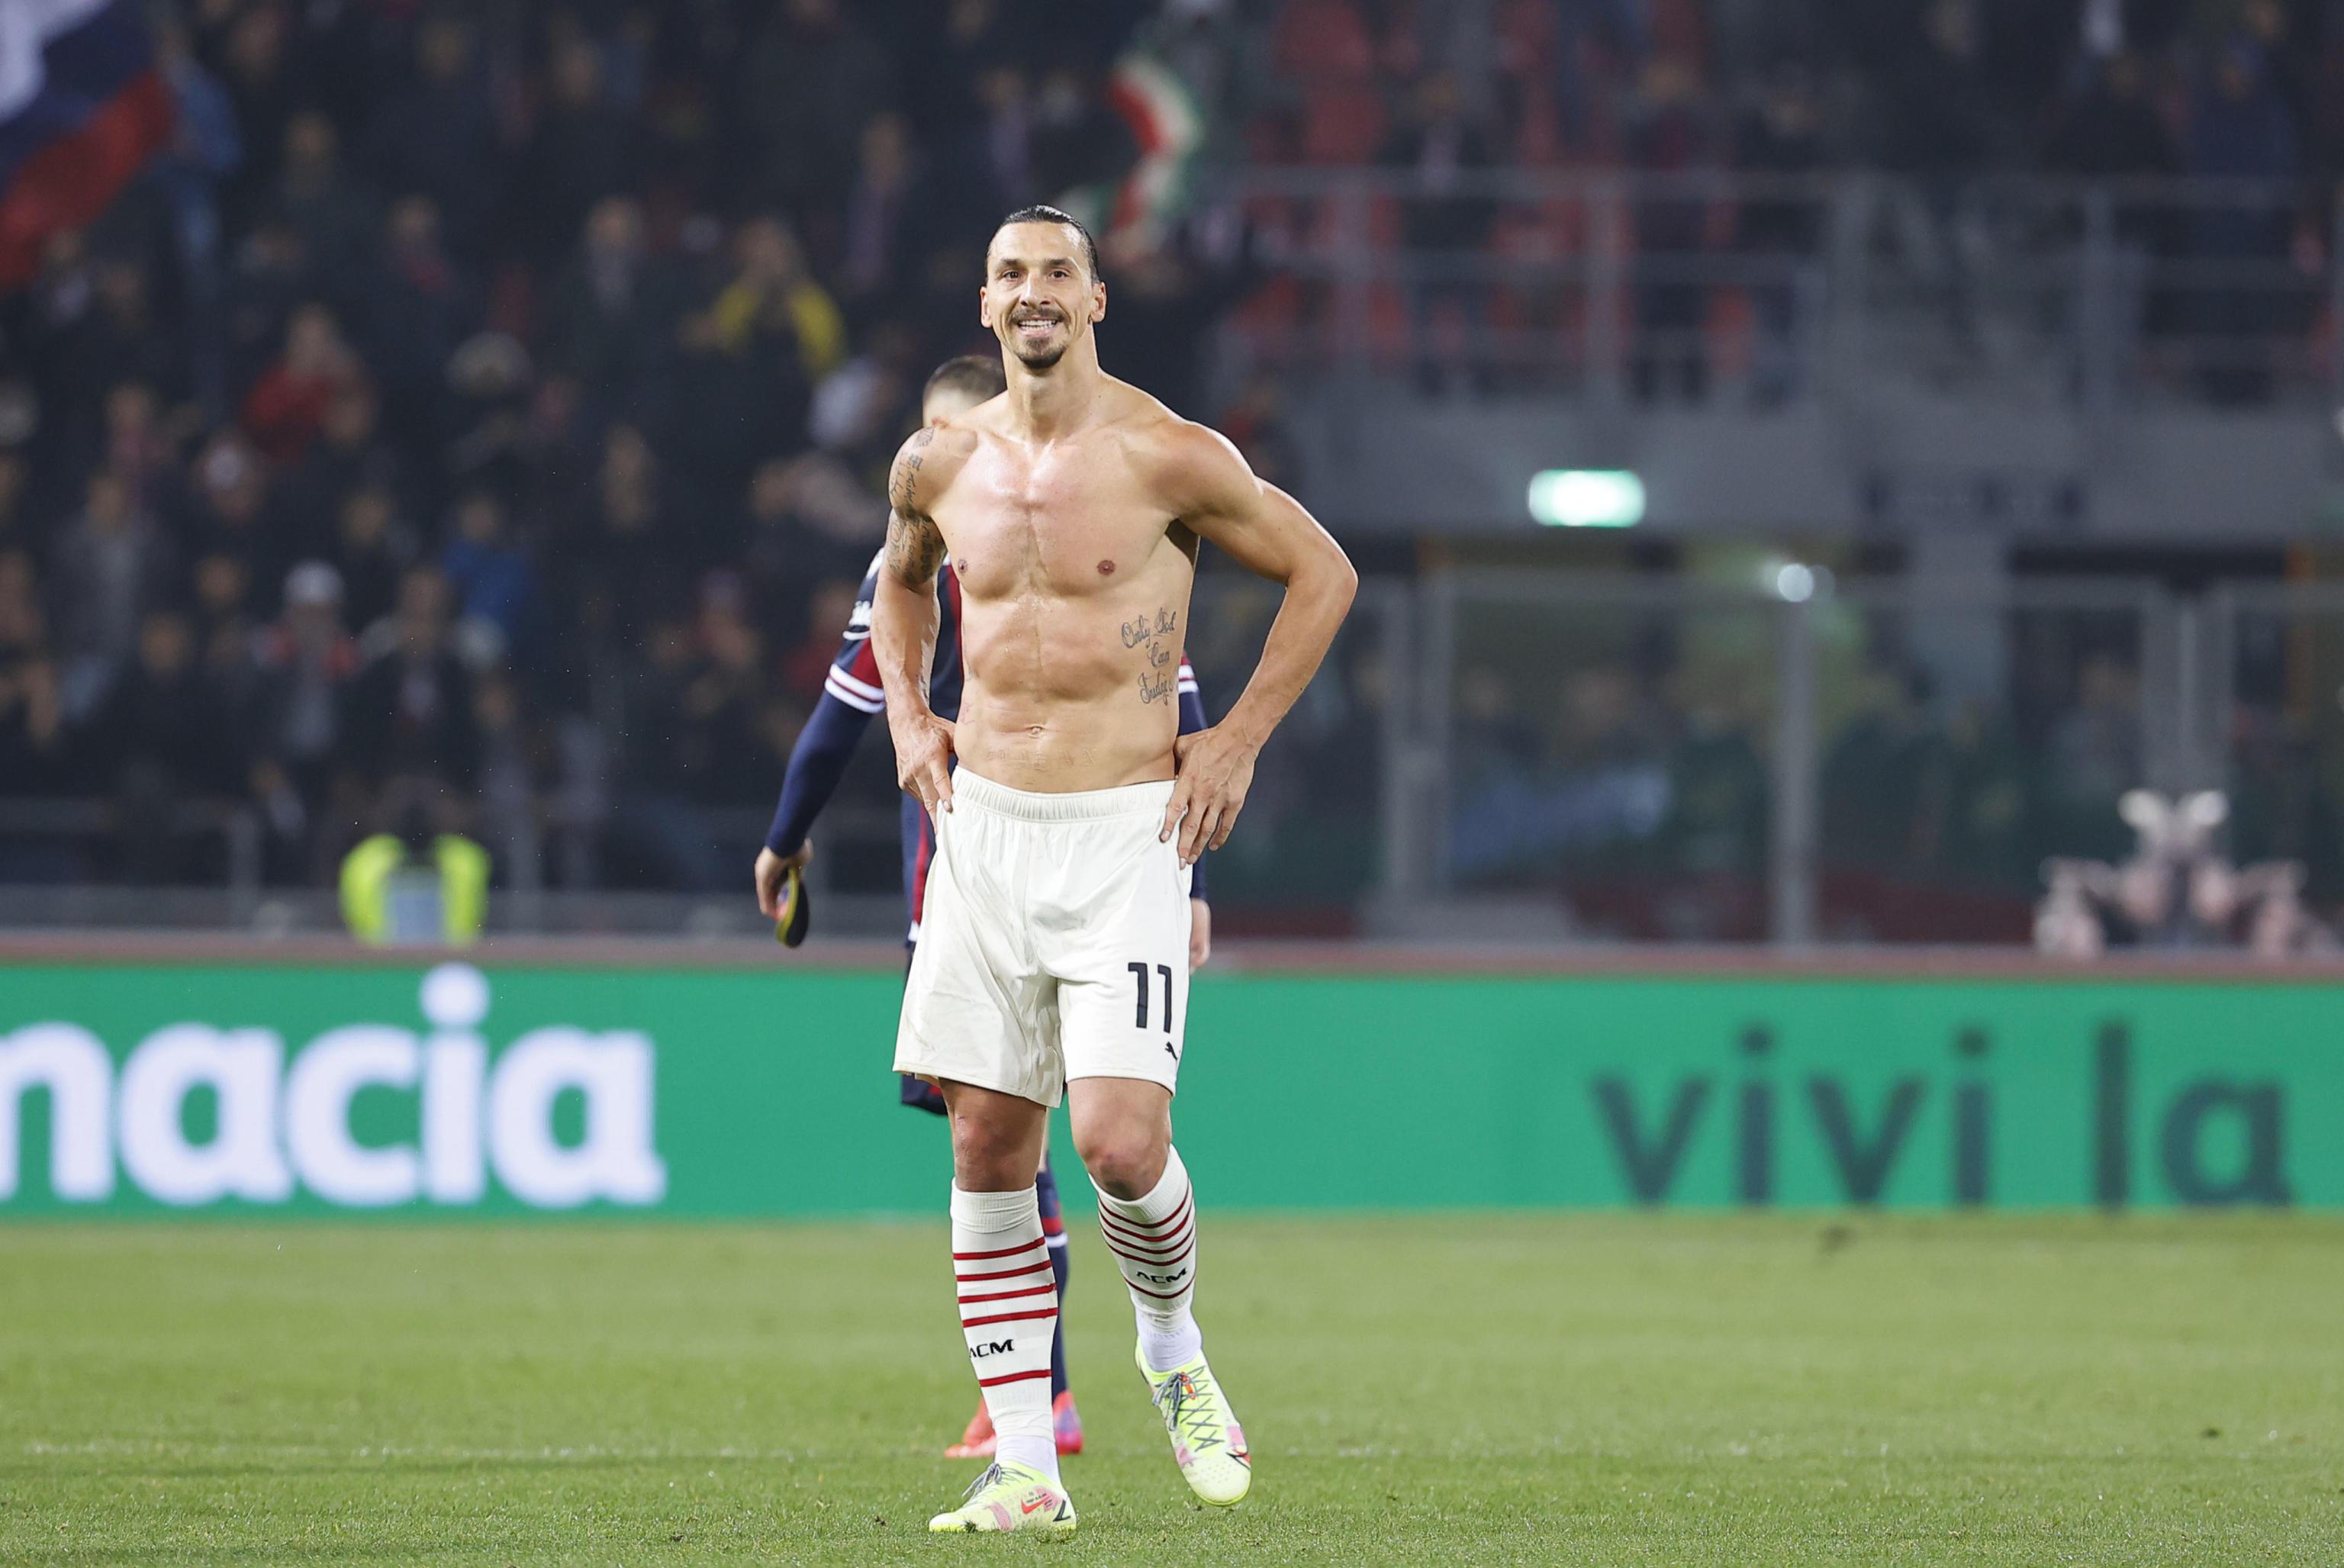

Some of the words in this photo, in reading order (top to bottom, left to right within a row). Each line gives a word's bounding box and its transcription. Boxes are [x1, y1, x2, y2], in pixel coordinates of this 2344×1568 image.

[1128, 962, 1172, 1033] 11
[1589, 1025, 1990, 1208] vivi
[2092, 1019, 2301, 1208] la
[1137, 1267, 1187, 1283] ACM
[969, 1338, 1015, 1358] ACM
